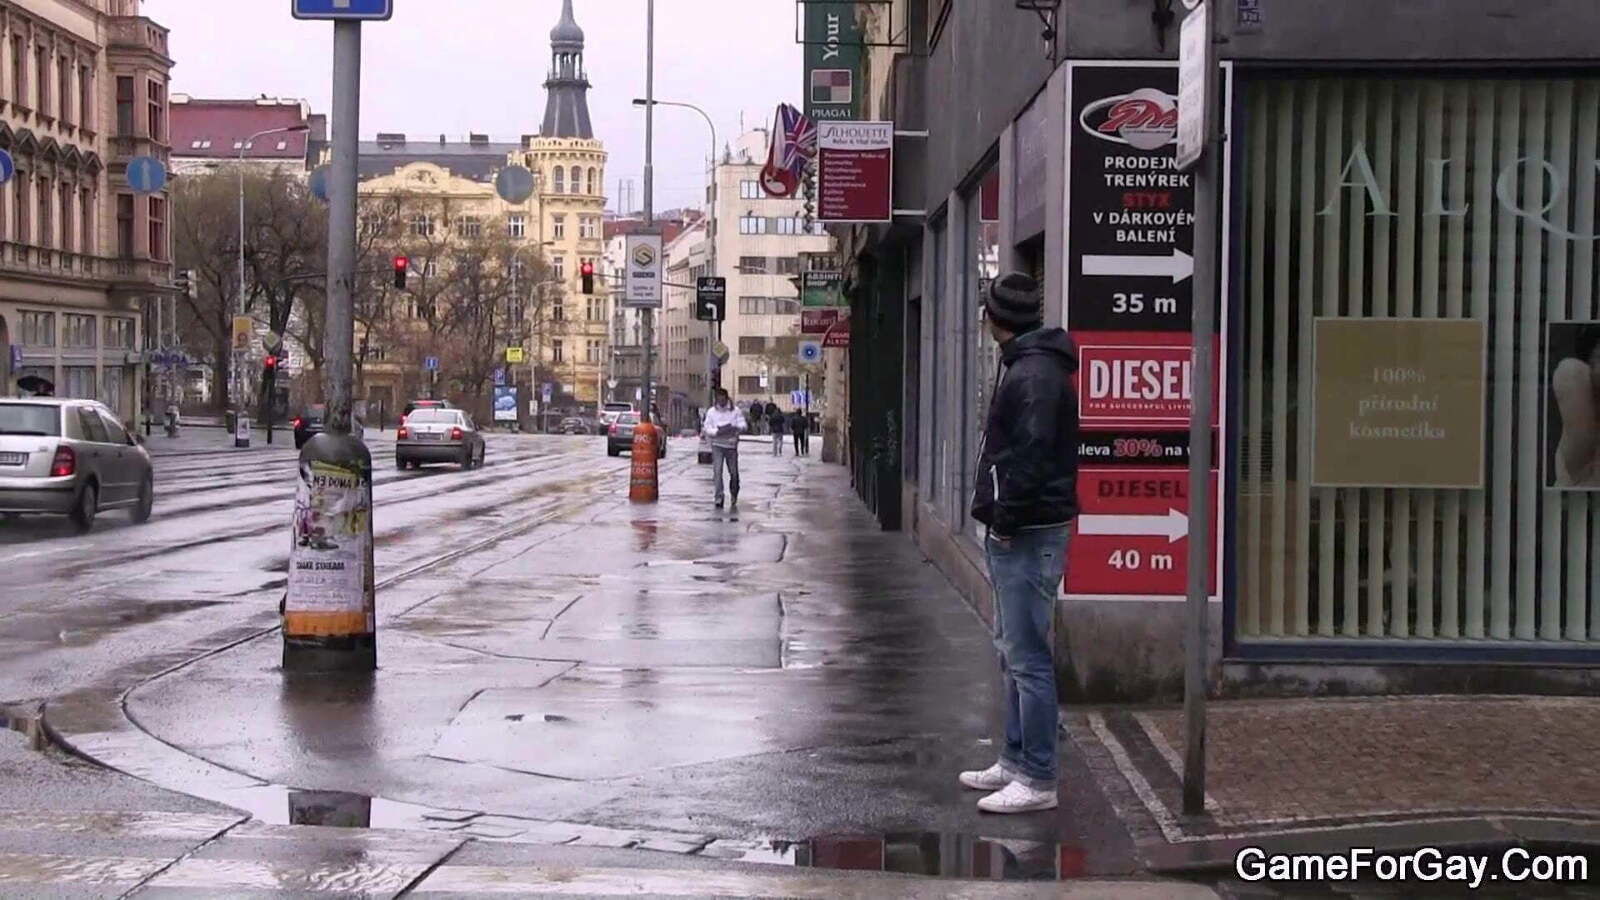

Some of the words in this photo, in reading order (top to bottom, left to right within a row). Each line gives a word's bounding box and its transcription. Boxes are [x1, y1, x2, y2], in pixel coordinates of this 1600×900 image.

[822, 12, 840, 61] Your
[1104, 156, 1178, 170] PRODEJN
[1104, 170, 1190, 188] TRENÝREK
[1315, 139, 1600, 240] ALQ
[1093, 212, 1104, 224] V
[1116, 227, 1176, 243] BALENÍ
[1112, 293, 1144, 313] 35
[1154, 297, 1177, 313] m
[1089, 359, 1192, 400] DIESEL
[1373, 367, 1426, 384] 100%
[1168, 403, 1192, 411] LIVIN
[1350, 421, 1446, 440] kosmetika
[1113, 438, 1163, 457] 30%
[1165, 445, 1183, 456] na
[1098, 480, 1188, 499] DIESEL
[1108, 549, 1141, 570] 40
[1151, 554, 1173, 570] m
